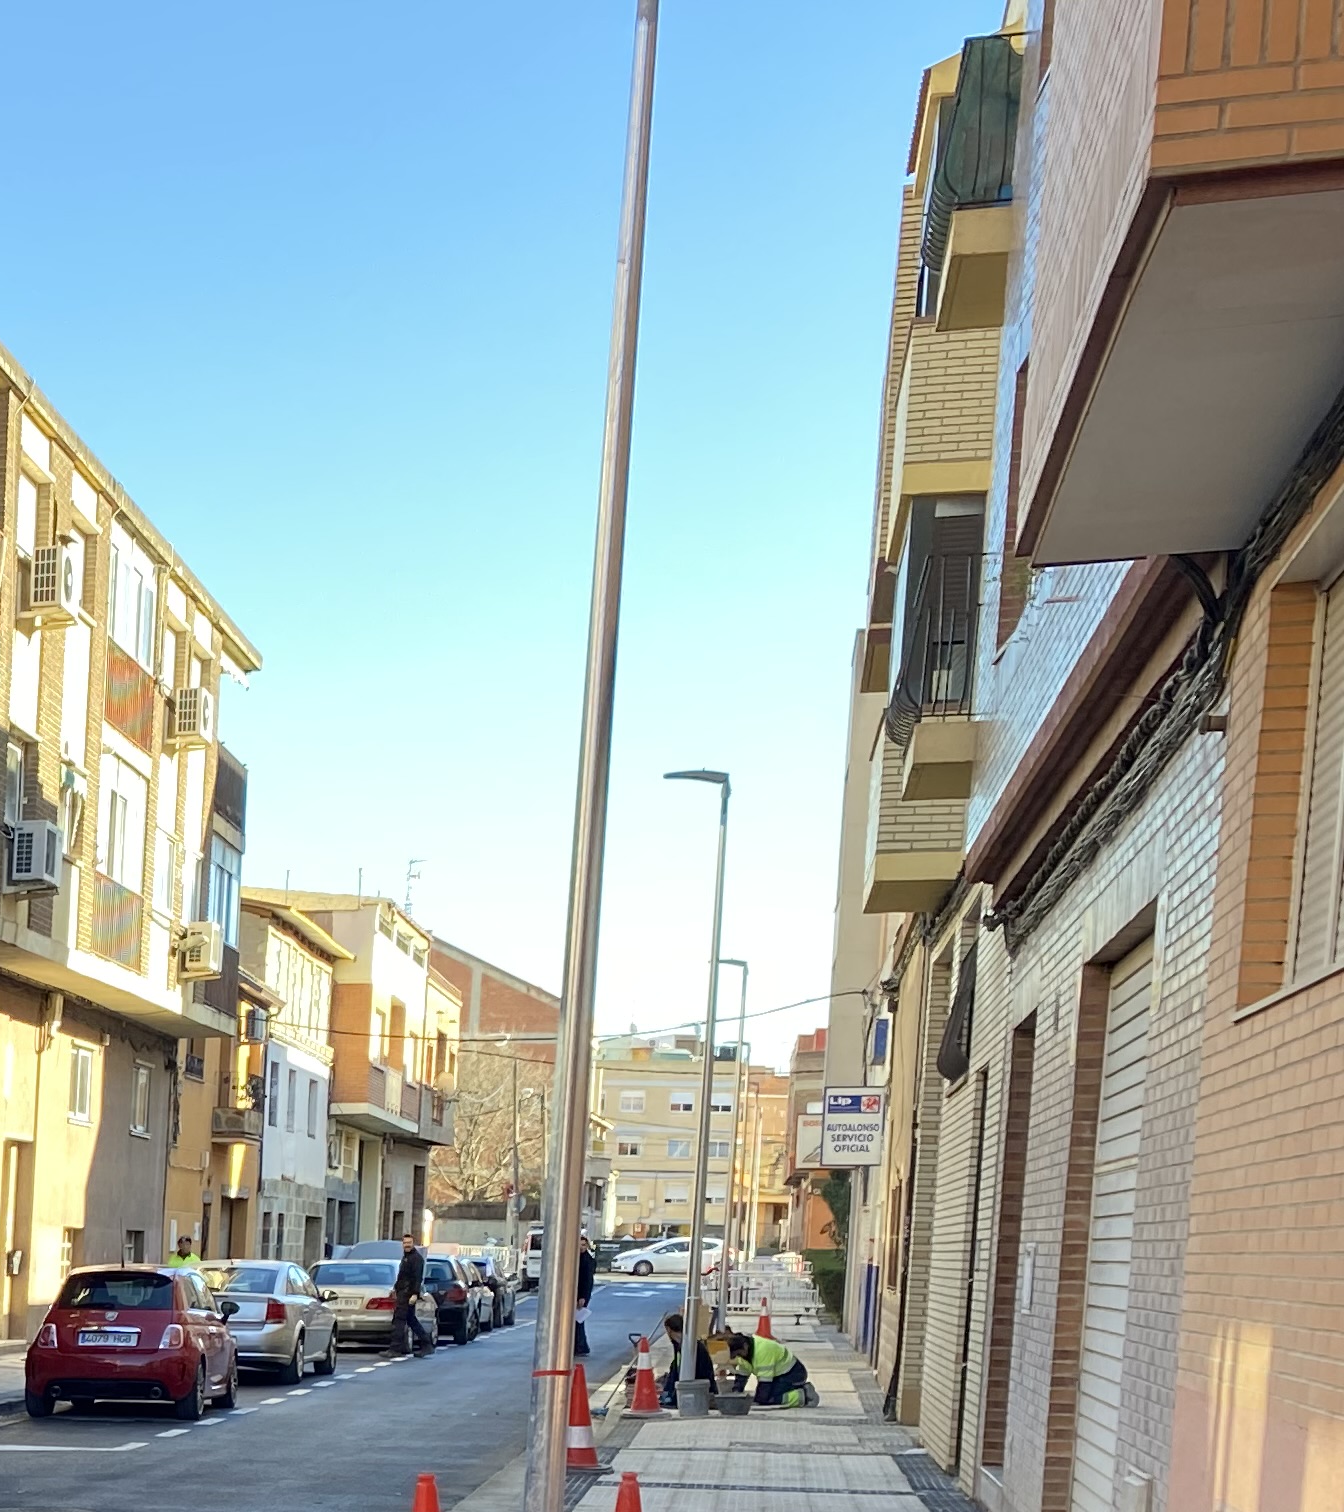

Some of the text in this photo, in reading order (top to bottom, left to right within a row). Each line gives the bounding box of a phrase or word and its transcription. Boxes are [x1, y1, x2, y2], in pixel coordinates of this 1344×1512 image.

[826, 1123, 880, 1132] AUTOALONSO
[831, 1133, 874, 1142] SERVICIO
[833, 1144, 871, 1153] OFICIAL
